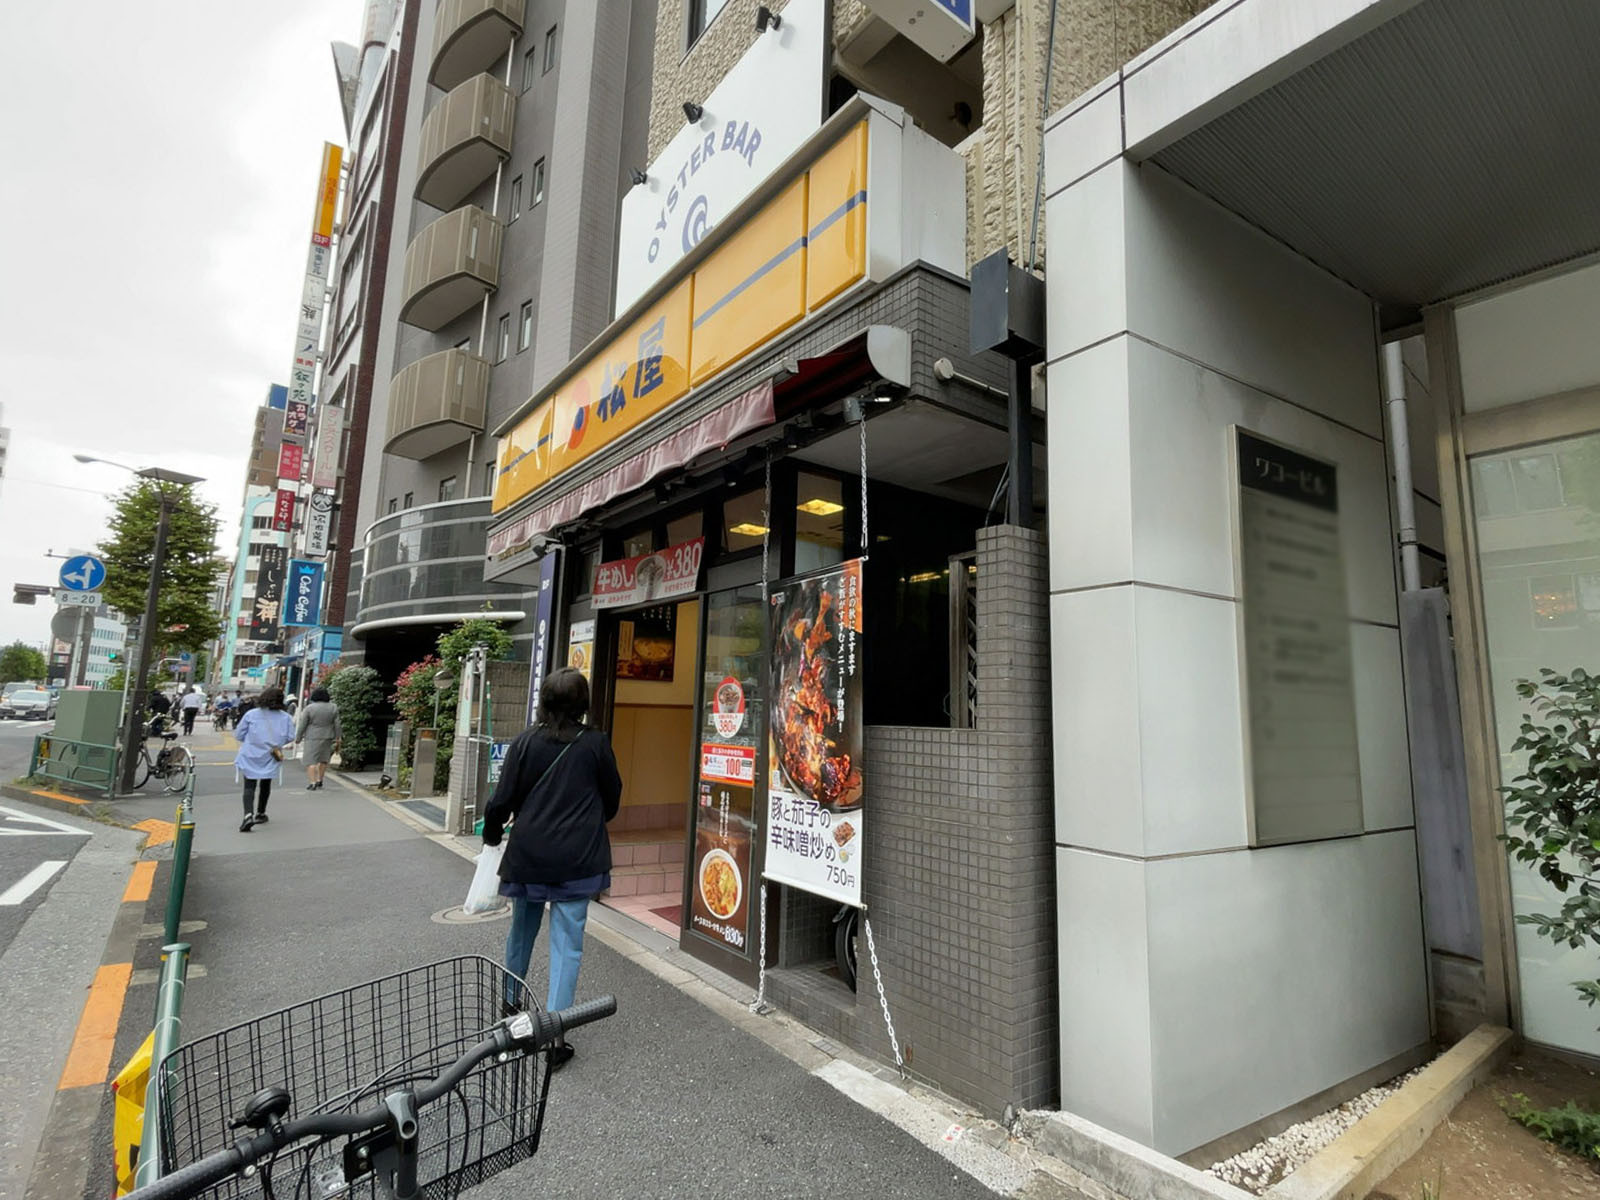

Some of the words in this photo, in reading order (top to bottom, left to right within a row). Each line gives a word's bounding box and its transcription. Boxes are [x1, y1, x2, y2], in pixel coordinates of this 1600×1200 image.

[648, 131, 716, 264] OYSTER
[720, 120, 762, 169] BAR
[596, 316, 666, 423] 松屋
[1255, 457, 1328, 496] ワコービル
[597, 564, 635, 592] 牛めし
[666, 541, 704, 580] ¥380
[295, 596, 310, 623] Coffee
[771, 795, 832, 829] 豚と茄子の
[771, 825, 837, 862] 辛味噌炒め
[826, 865, 856, 888] 750円
